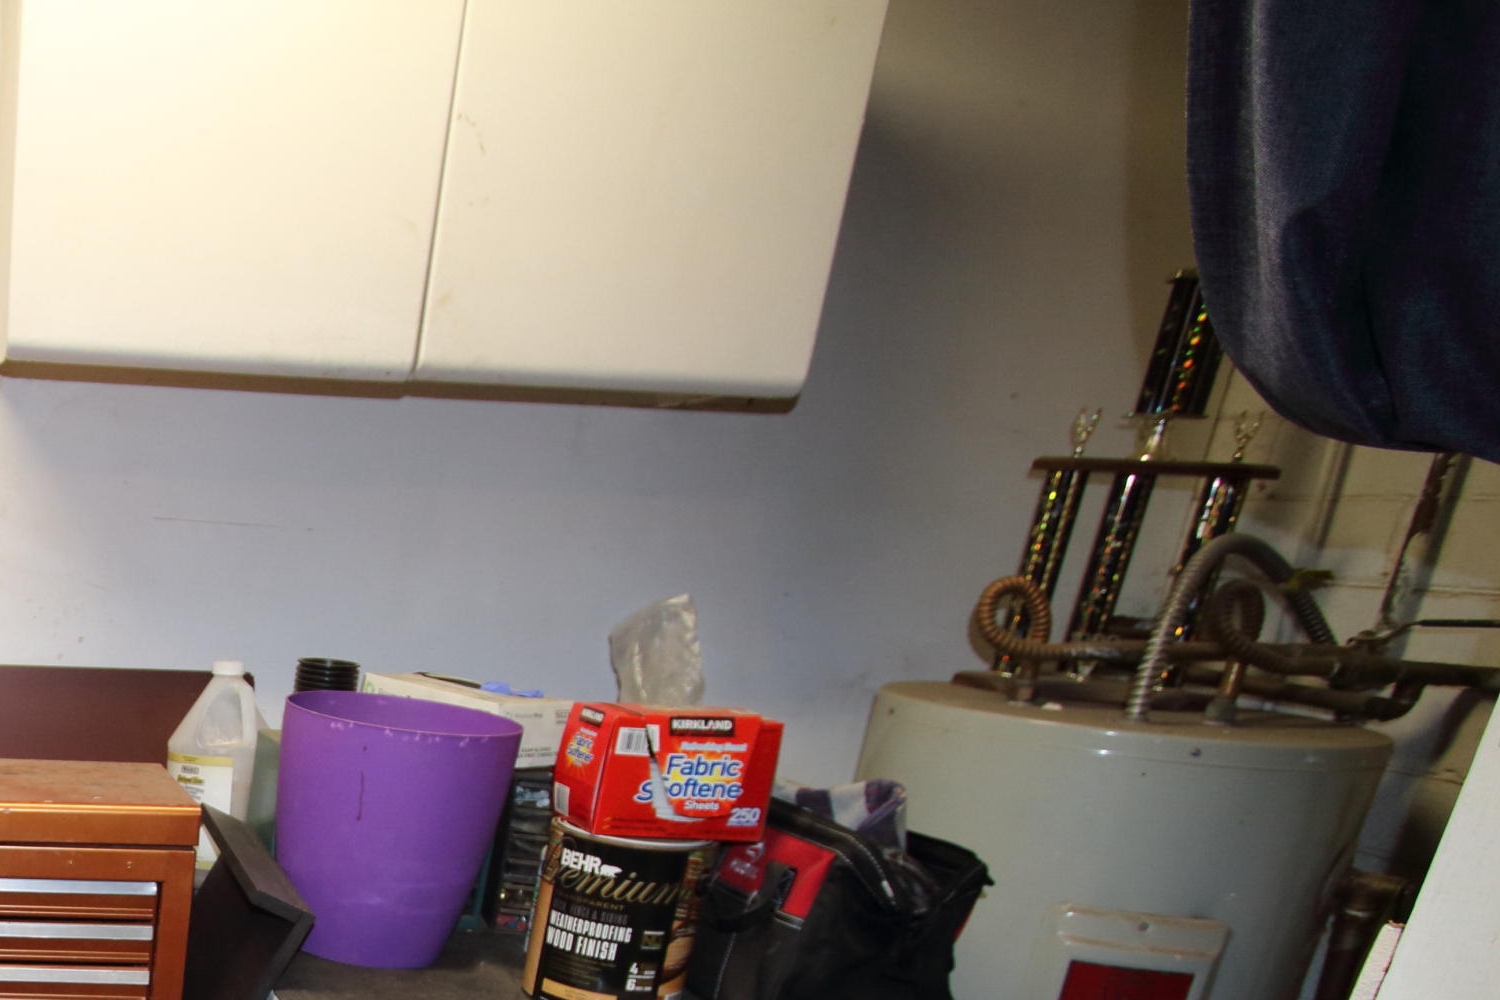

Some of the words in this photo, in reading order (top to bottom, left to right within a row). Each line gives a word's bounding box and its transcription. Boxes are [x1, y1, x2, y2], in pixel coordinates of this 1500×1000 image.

[671, 718, 733, 732] KIRKLAND
[666, 754, 742, 777] Fabric
[636, 777, 742, 802] Softene
[730, 807, 760, 823] 250
[561, 847, 601, 874] BEHR
[550, 908, 633, 944] WEATHERPROOFING
[546, 925, 573, 951] WOOD
[576, 936, 618, 961] FINISH
